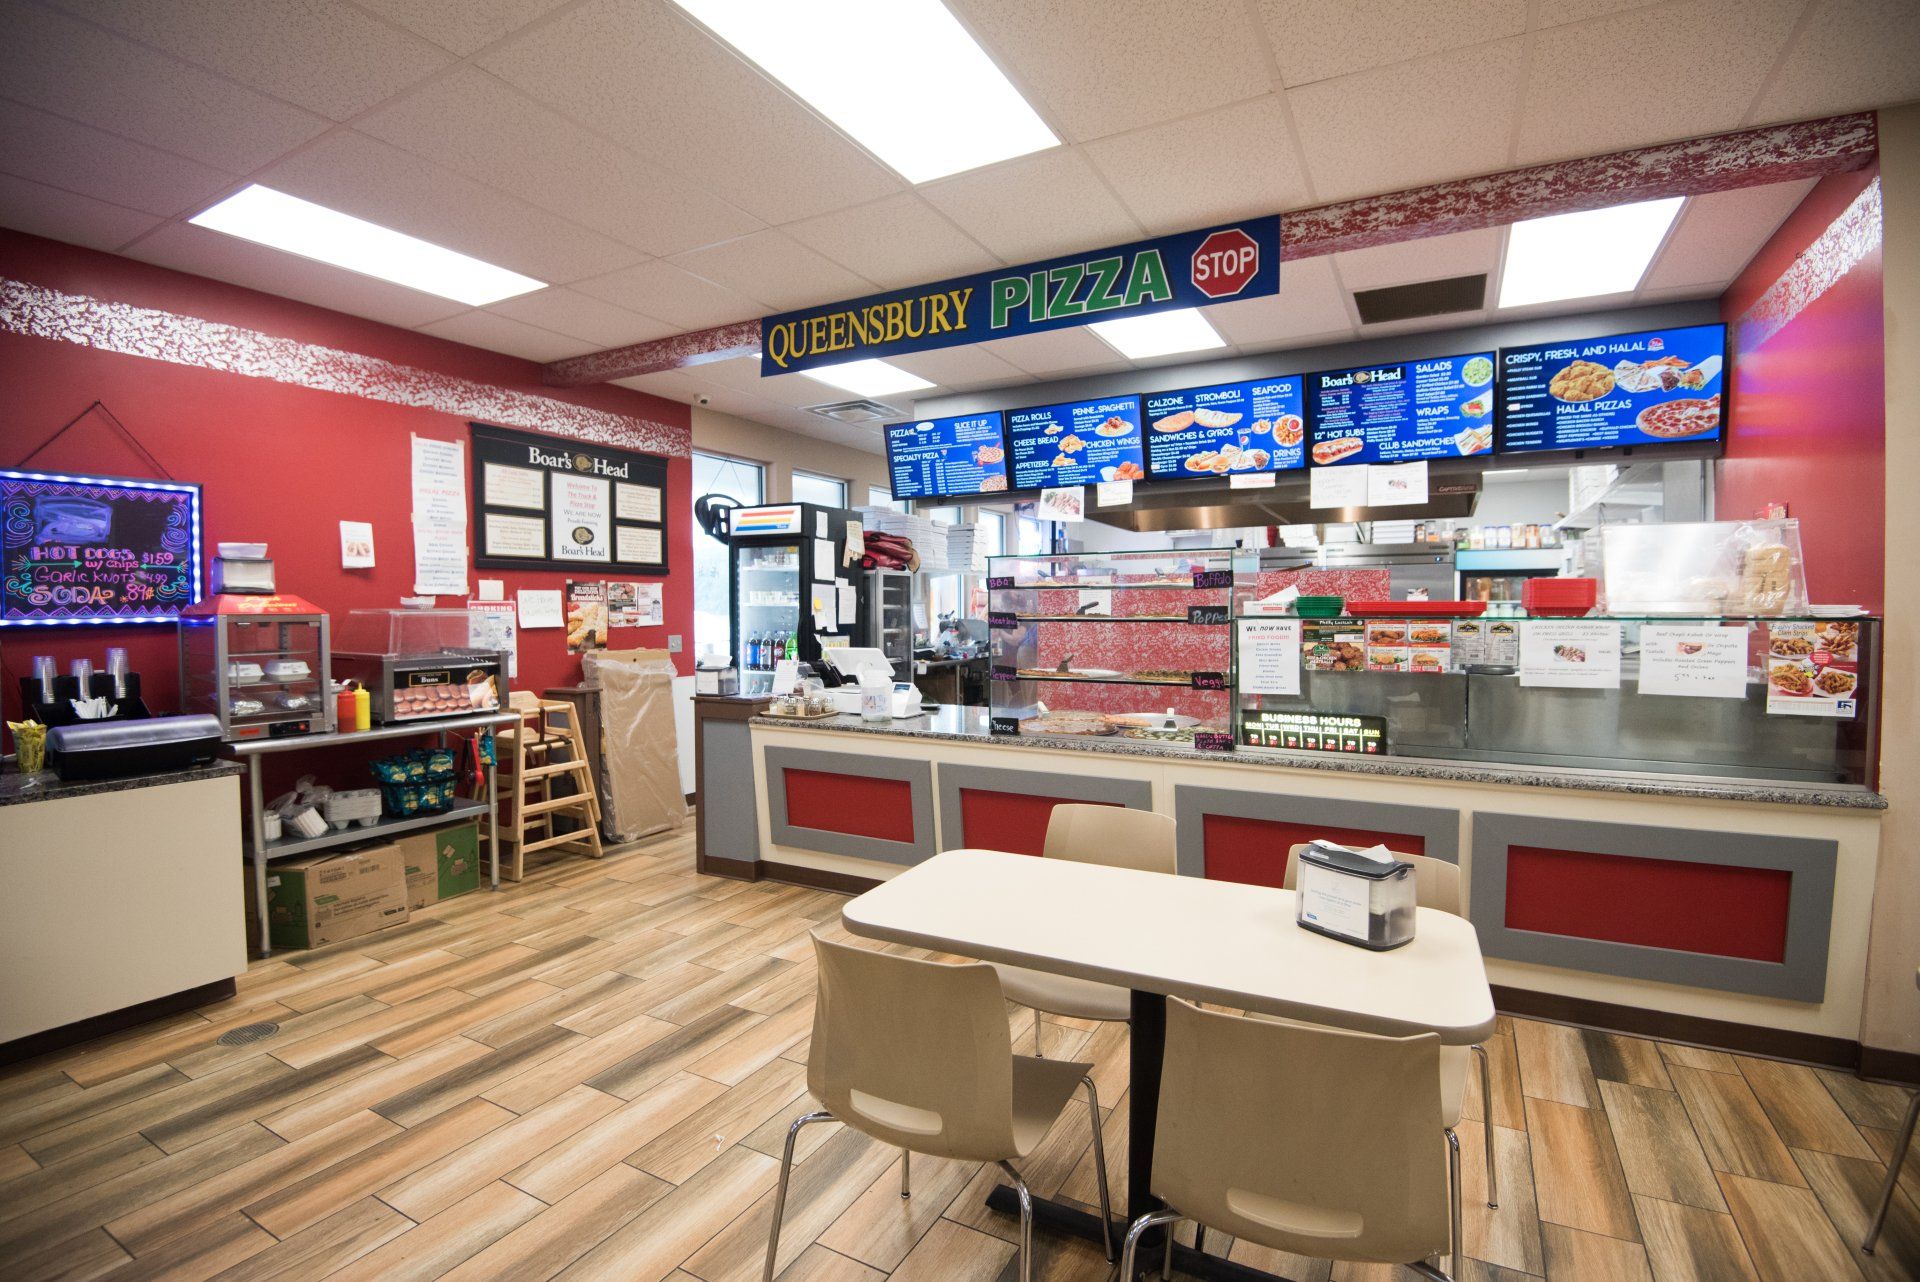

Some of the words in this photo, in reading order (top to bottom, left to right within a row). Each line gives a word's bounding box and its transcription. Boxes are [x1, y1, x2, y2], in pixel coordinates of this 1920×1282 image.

[768, 288, 974, 368] QUEENSBURY
[990, 248, 1172, 329] PIZZA
[1194, 244, 1256, 280] STOP
[1582, 346, 1606, 357] AND
[1609, 342, 1645, 354] HALAL
[1416, 361, 1452, 373] SALADS
[1370, 368, 1401, 382] Head
[1195, 390, 1240, 402] STROMBOLI
[1252, 384, 1292, 396] SEAFOOD
[1148, 397, 1183, 408] CALZONE
[1556, 403, 1592, 414] HALAL
[1595, 399, 1632, 411] PIZZAS
[1073, 407, 1095, 416] PENNE
[1098, 402, 1134, 412] SPAGHETTI
[1416, 406, 1449, 416] WRAPS
[1012, 415, 1030, 423] PIZZA
[1031, 412, 1052, 420] ROLLS
[954, 422, 970, 430] SLICE
[1150, 432, 1197, 443] SANDWICHES
[1207, 428, 1233, 437] GYROS
[1327, 430, 1343, 438] HOT
[1345, 428, 1365, 437] SUBS
[1014, 438, 1036, 447] CHEESE
[1038, 436, 1058, 444] BREAD
[1086, 440, 1115, 448] CHICKEN
[1117, 437, 1140, 445] WINGS
[1379, 442, 1399, 450] CLUB
[1402, 437, 1455, 448] SANDWICHES
[894, 454, 921, 462] SPECIALTY
[1273, 448, 1301, 458] DRINKS
[528, 447, 572, 470] Boar's
[593, 458, 628, 478] Head
[1016, 460, 1049, 470] APPETIZERS
[30, 546, 80, 560] HOT
[84, 547, 136, 560] DOGS
[562, 546, 583, 556] Boar's
[586, 546, 605, 556] Head
[106, 560, 139, 572] Chips
[990, 579, 1008, 588] BBQ
[1194, 572, 1231, 587] Buffalo
[28, 584, 114, 605] SODA
[1261, 713, 1318, 724] BUSINESS
[1320, 716, 1361, 727] HOURS
